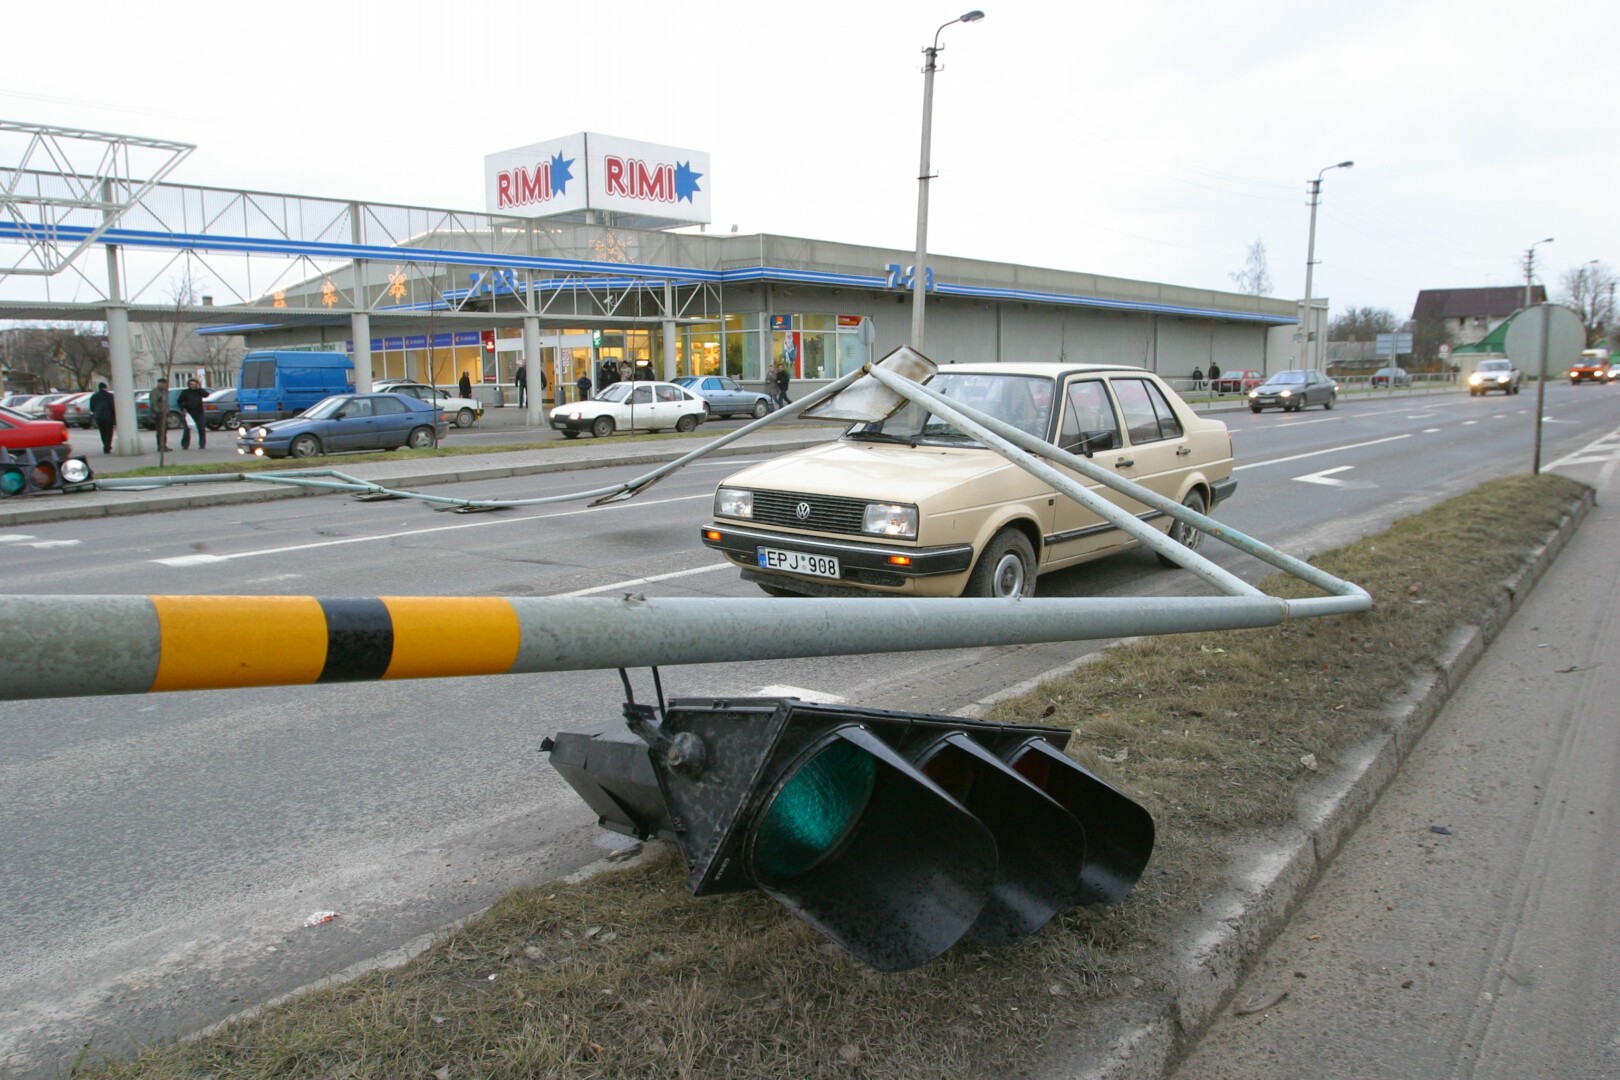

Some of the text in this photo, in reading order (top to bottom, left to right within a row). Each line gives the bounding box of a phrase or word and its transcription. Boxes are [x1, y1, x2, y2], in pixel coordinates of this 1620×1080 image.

[497, 161, 552, 209] RIMI
[604, 155, 676, 203] RIMI
[767, 550, 799, 570] EPJ
[808, 556, 836, 576] 908
